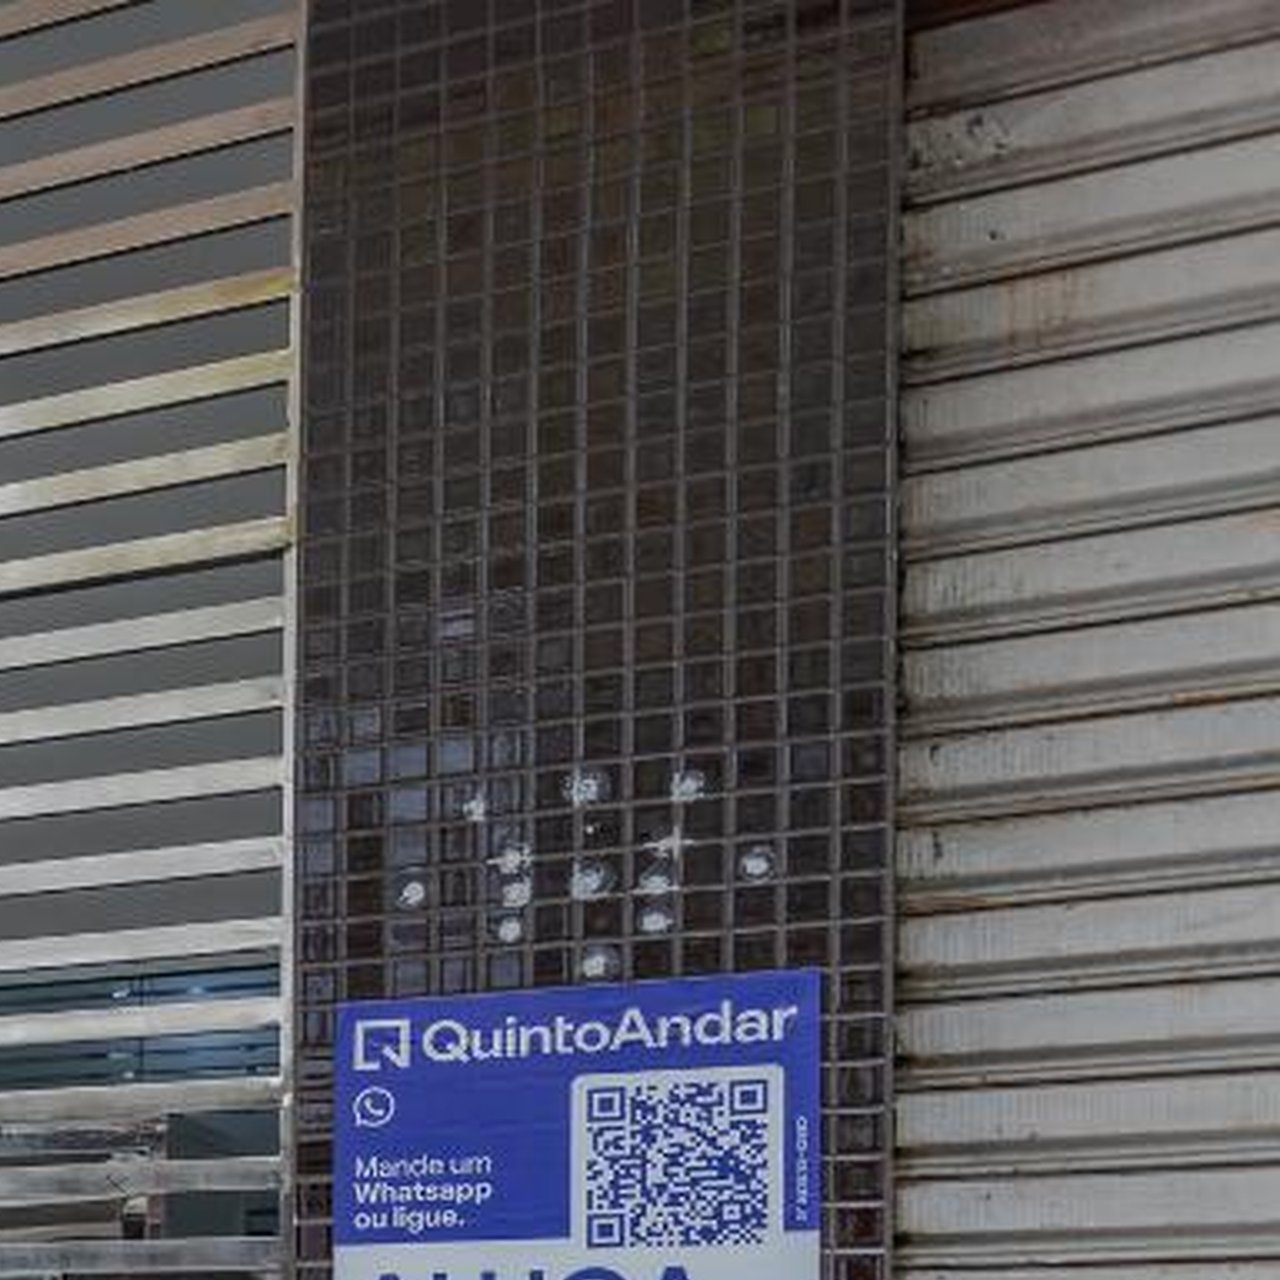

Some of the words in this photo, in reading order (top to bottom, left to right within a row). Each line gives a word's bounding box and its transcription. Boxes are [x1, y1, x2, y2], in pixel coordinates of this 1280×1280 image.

[422, 1000, 798, 1064] QuintoAndar
[354, 1154, 445, 1178] Mande
[449, 1155, 493, 1175] um
[353, 1181, 493, 1205] Whatsapp
[353, 1211, 388, 1229] ou
[392, 1206, 465, 1235] ligue.
